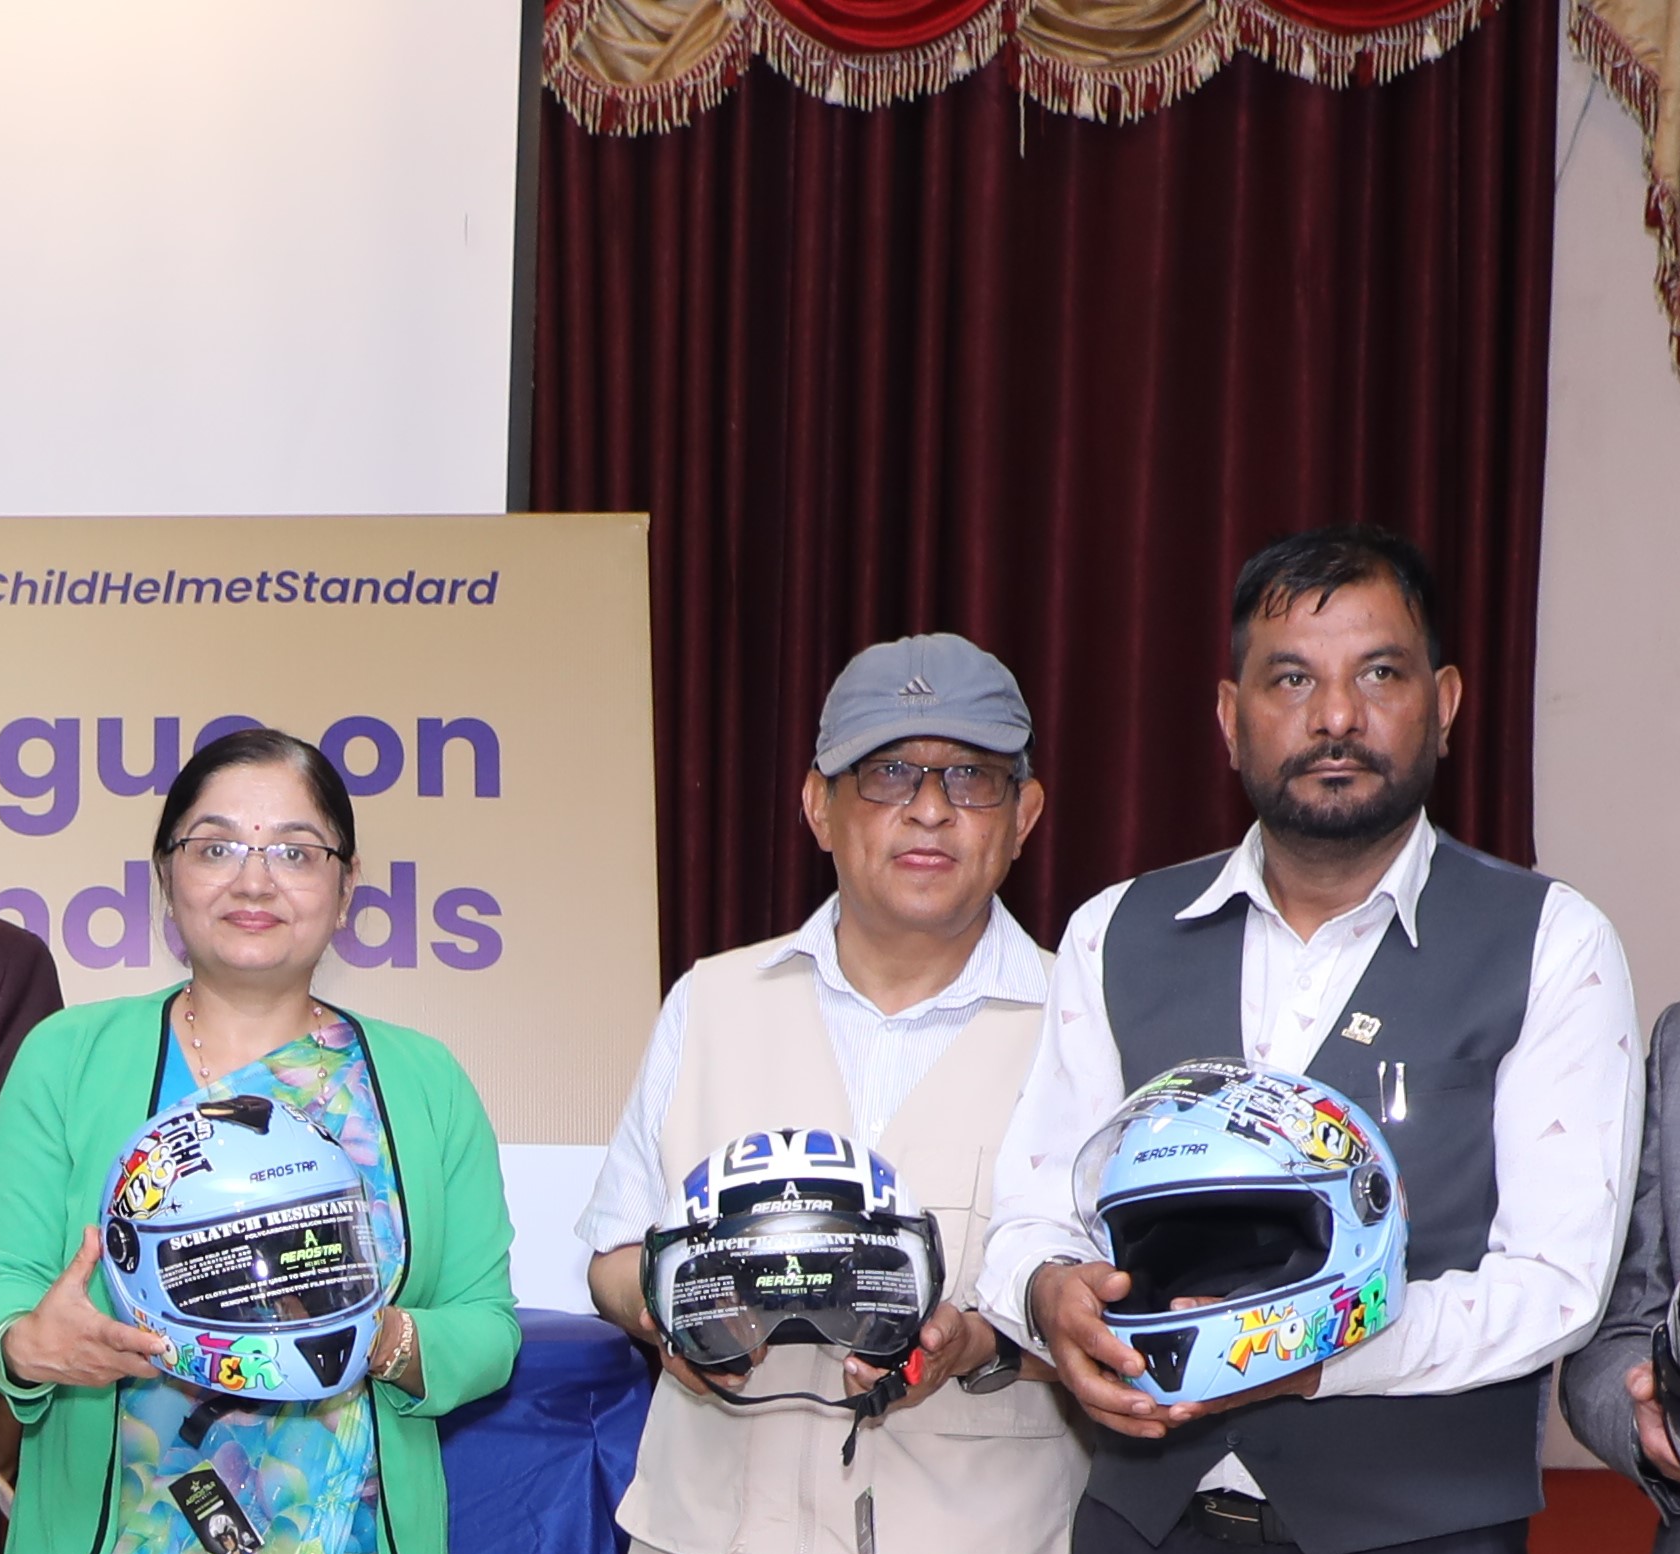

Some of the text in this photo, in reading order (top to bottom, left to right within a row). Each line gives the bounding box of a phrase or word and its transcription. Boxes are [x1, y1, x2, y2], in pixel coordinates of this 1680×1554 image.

[318, 714, 502, 799] on
[1133, 1143, 1209, 1165] AEROSTAR
[249, 1160, 319, 1184] AEROSTAR
[751, 1199, 833, 1214] AEROSTAR
[170, 1216, 262, 1250] SCRATCH
[265, 1200, 355, 1227] RESISTANT
[280, 1243, 342, 1265] AEROSTAR
[755, 1273, 833, 1288] AEROSTAR
[1223, 1268, 1389, 1376] MONSTER
[135, 1307, 287, 1392] ONSTER
